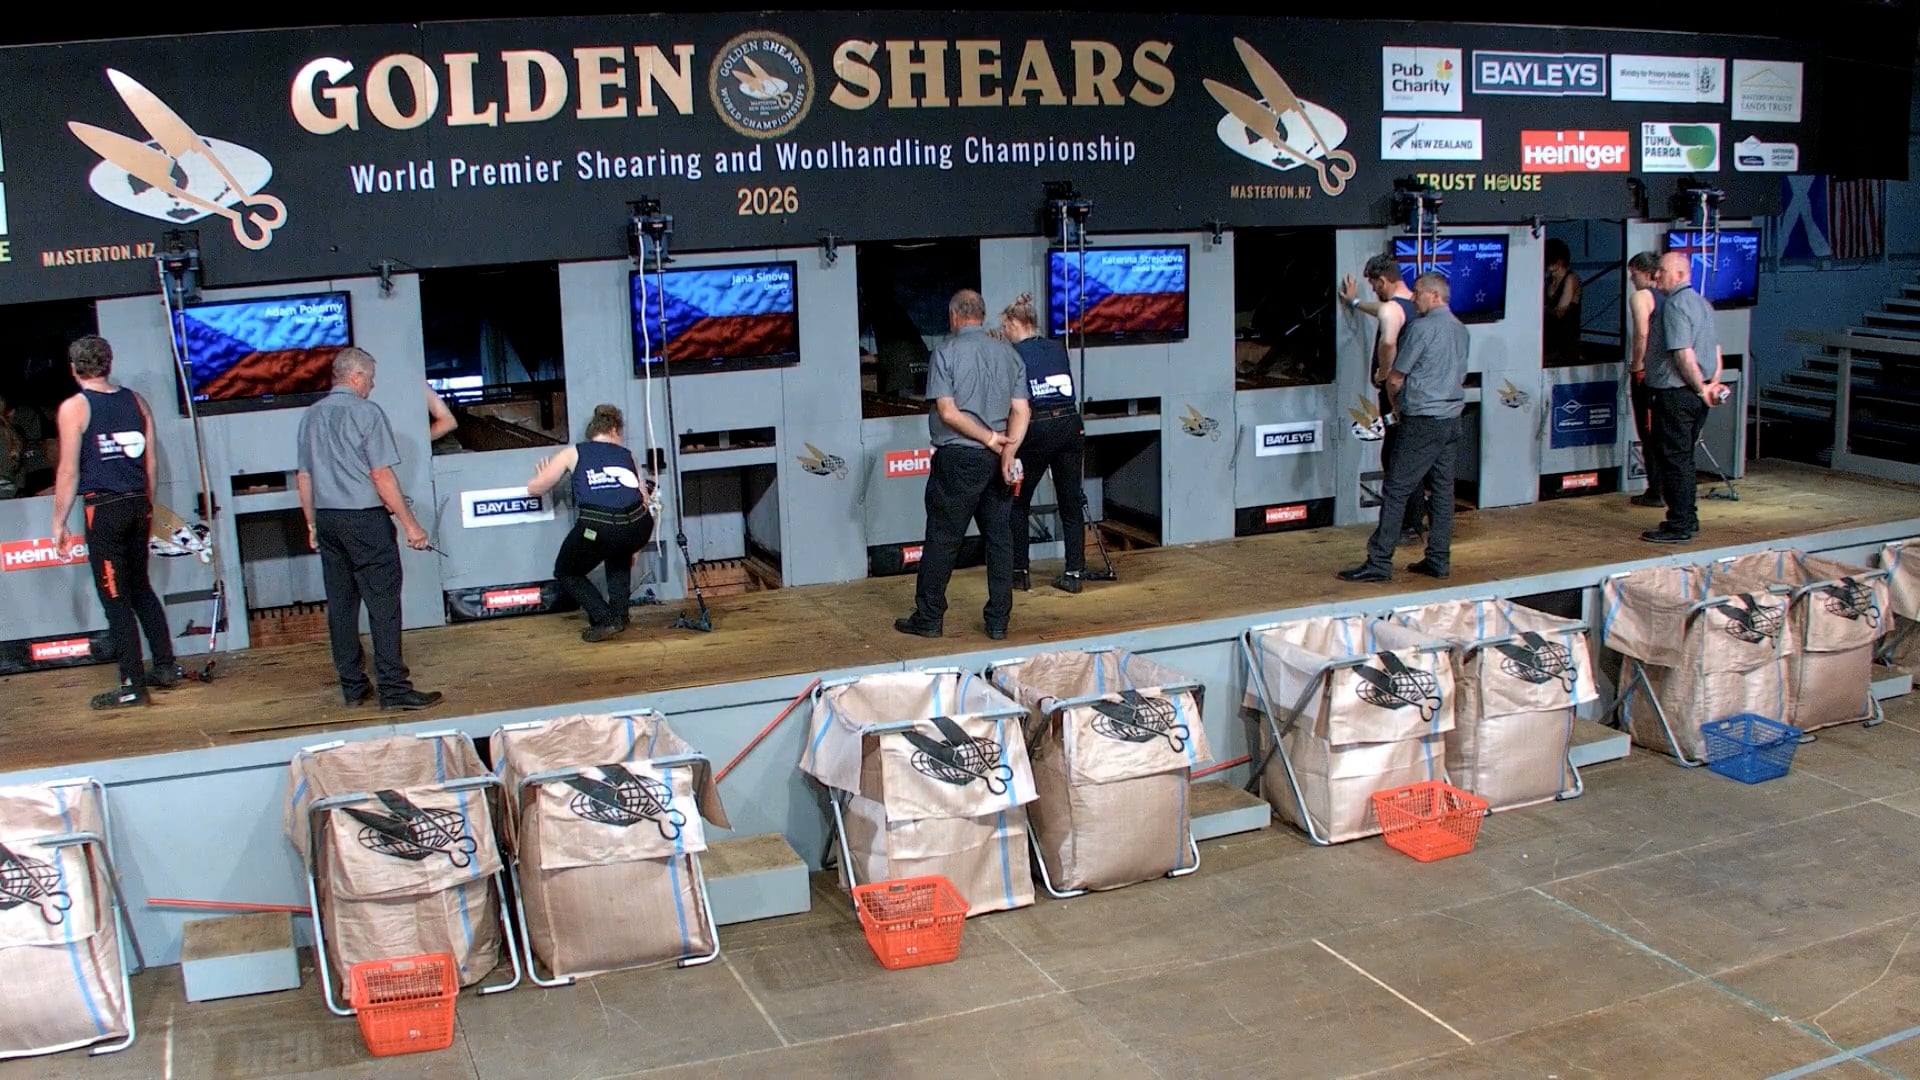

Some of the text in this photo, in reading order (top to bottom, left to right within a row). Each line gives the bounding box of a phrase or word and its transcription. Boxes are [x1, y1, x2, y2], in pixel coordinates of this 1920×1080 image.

[720, 41, 803, 77] GOLDEN SHEARS
[1391, 63, 1423, 77] Pub
[1482, 61, 1598, 87] BAYLEYS
[291, 39, 1176, 134] GOLDEN SHEARS
[1392, 79, 1450, 96] Charity
[721, 84, 805, 130] WORLD CHAMPIONSHIPS
[1645, 125, 1656, 135] TE
[1411, 140, 1473, 149] NEW ZEALAND
[1645, 136, 1671, 146] TUMU
[1524, 132, 1626, 169] Heiniger
[1645, 147, 1681, 158] PAEROA
[350, 135, 1136, 194] World Premier Shearing and Woolhandling Championship
[1416, 173, 1542, 191] TRUST HOUSE
[1230, 185, 1312, 199] MASTERTON.NZ
[738, 187, 798, 215] 2026
[42, 242, 156, 267] MASTERTON.NZ
[732, 272, 790, 285] Jana Sinova
[265, 307, 297, 316] Adam
[1266, 433, 1313, 445] BAYLEYS
[477, 500, 539, 514] BAYLEYS
[37, 641, 90, 656] Heiniger
